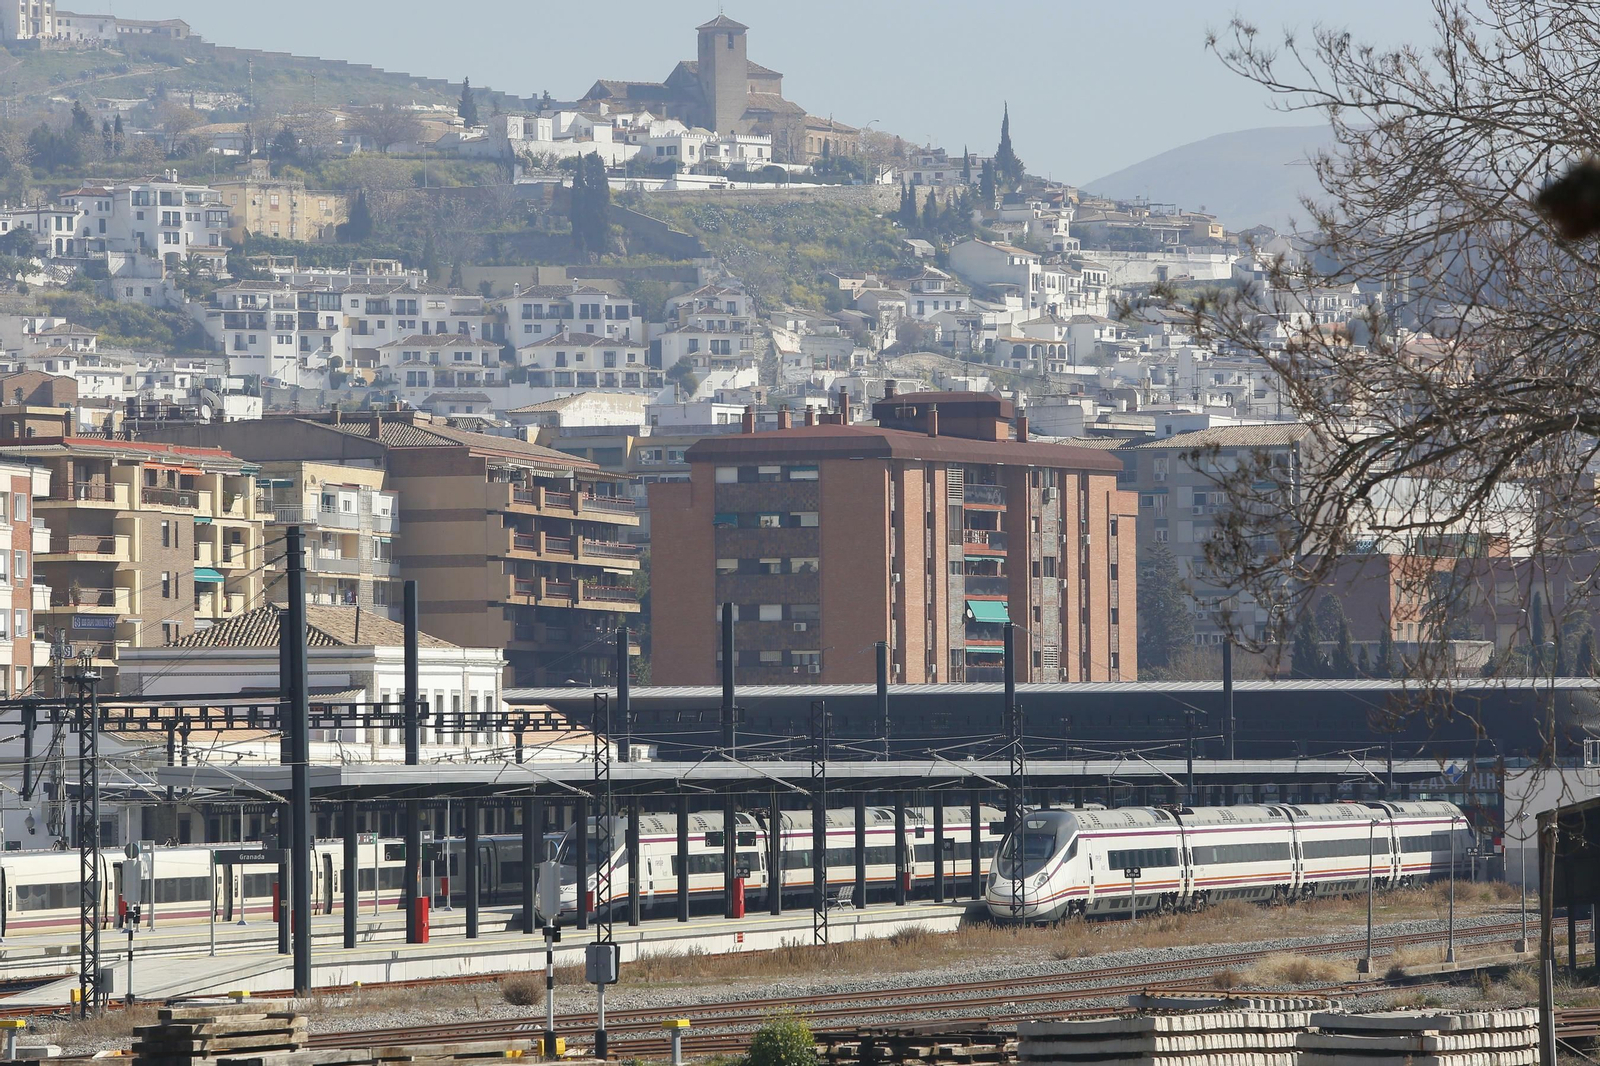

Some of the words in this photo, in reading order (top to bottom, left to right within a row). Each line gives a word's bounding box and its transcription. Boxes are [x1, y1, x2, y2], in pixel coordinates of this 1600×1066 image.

[706, 839, 712, 847] 6
[750, 838, 756, 846] 7
[385, 852, 391, 860] 6
[436, 851, 442, 860] 7
